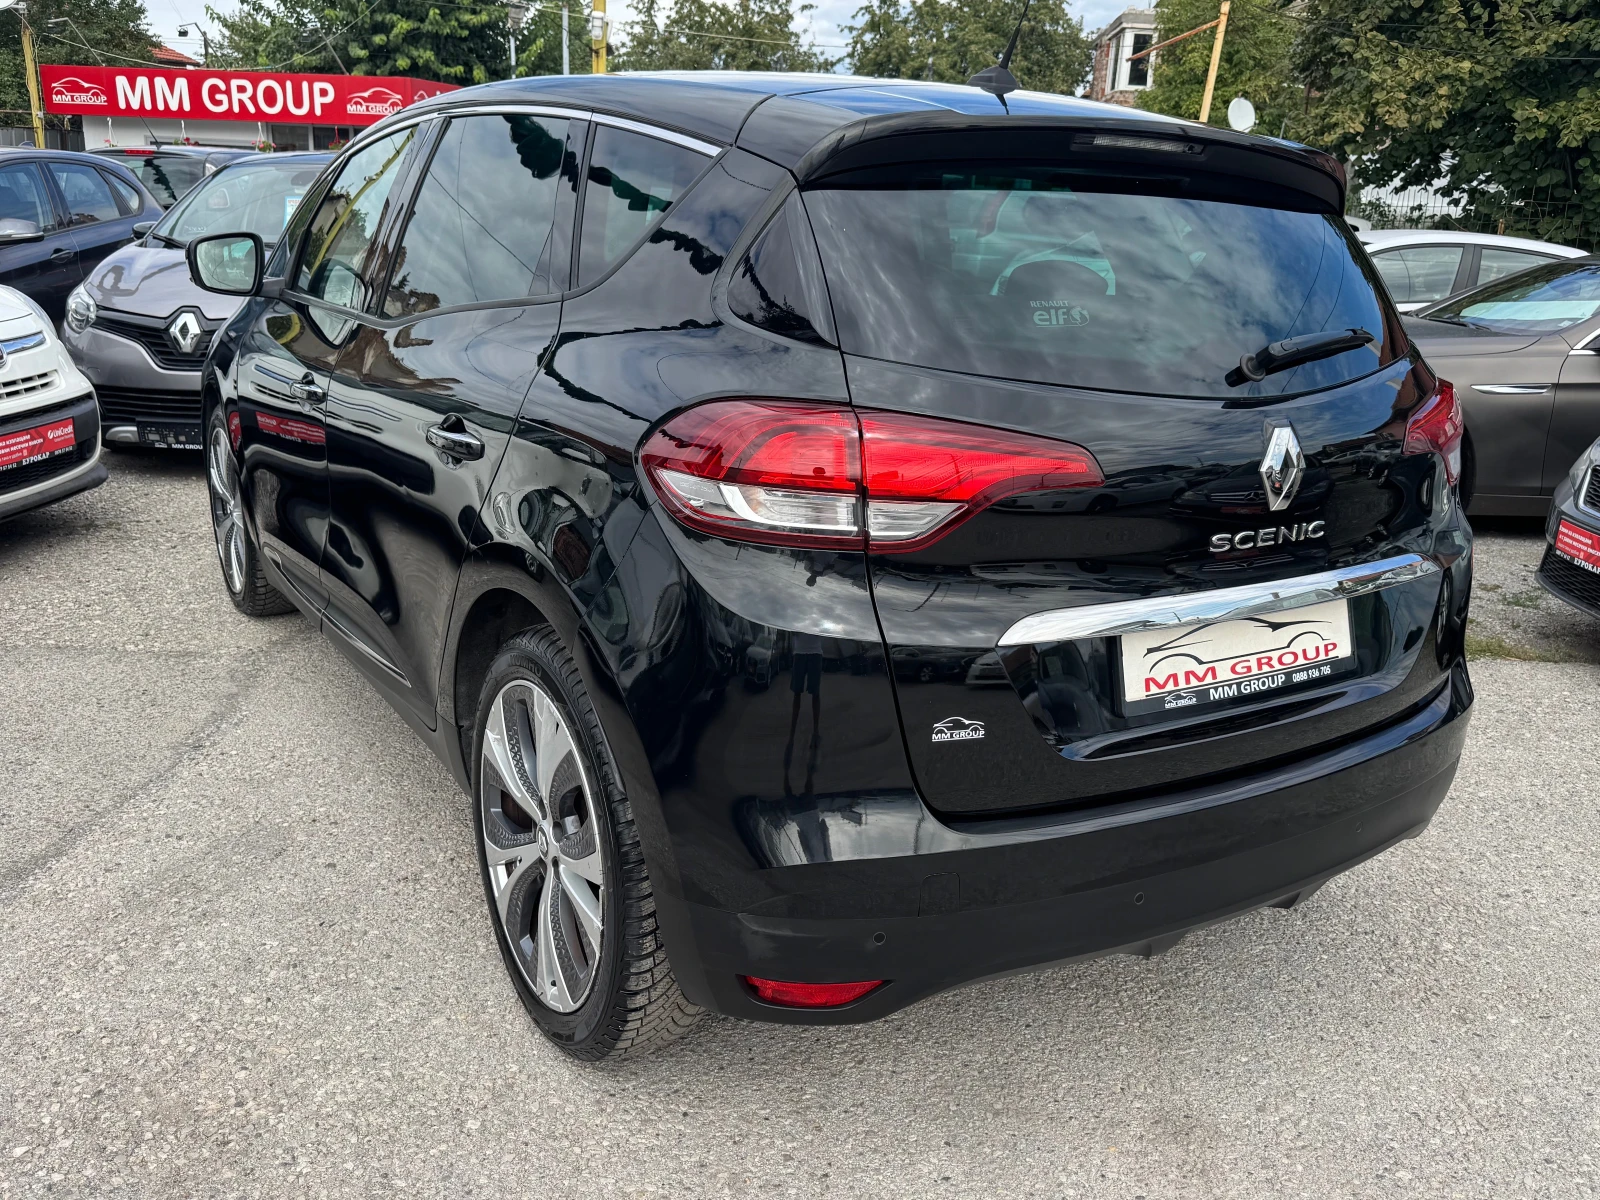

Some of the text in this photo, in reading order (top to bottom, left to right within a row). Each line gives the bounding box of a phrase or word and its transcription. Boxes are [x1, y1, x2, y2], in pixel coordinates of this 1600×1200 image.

[52, 94, 107, 103] MM GROUP
[115, 75, 335, 117] MM GROUP
[347, 104, 366, 113] MM
[1030, 300, 1069, 308] RENAULT
[1033, 309, 1068, 325] elf
[53, 425, 72, 437] UniCredit
[22, 451, 50, 466] ЕУРОКАР
[1208, 520, 1326, 553] SCENIC
[1144, 642, 1338, 693] MM GROUP
[1209, 665, 1331, 701] MM GROUP 0888 936 705
[952, 730, 985, 738] GROUP
